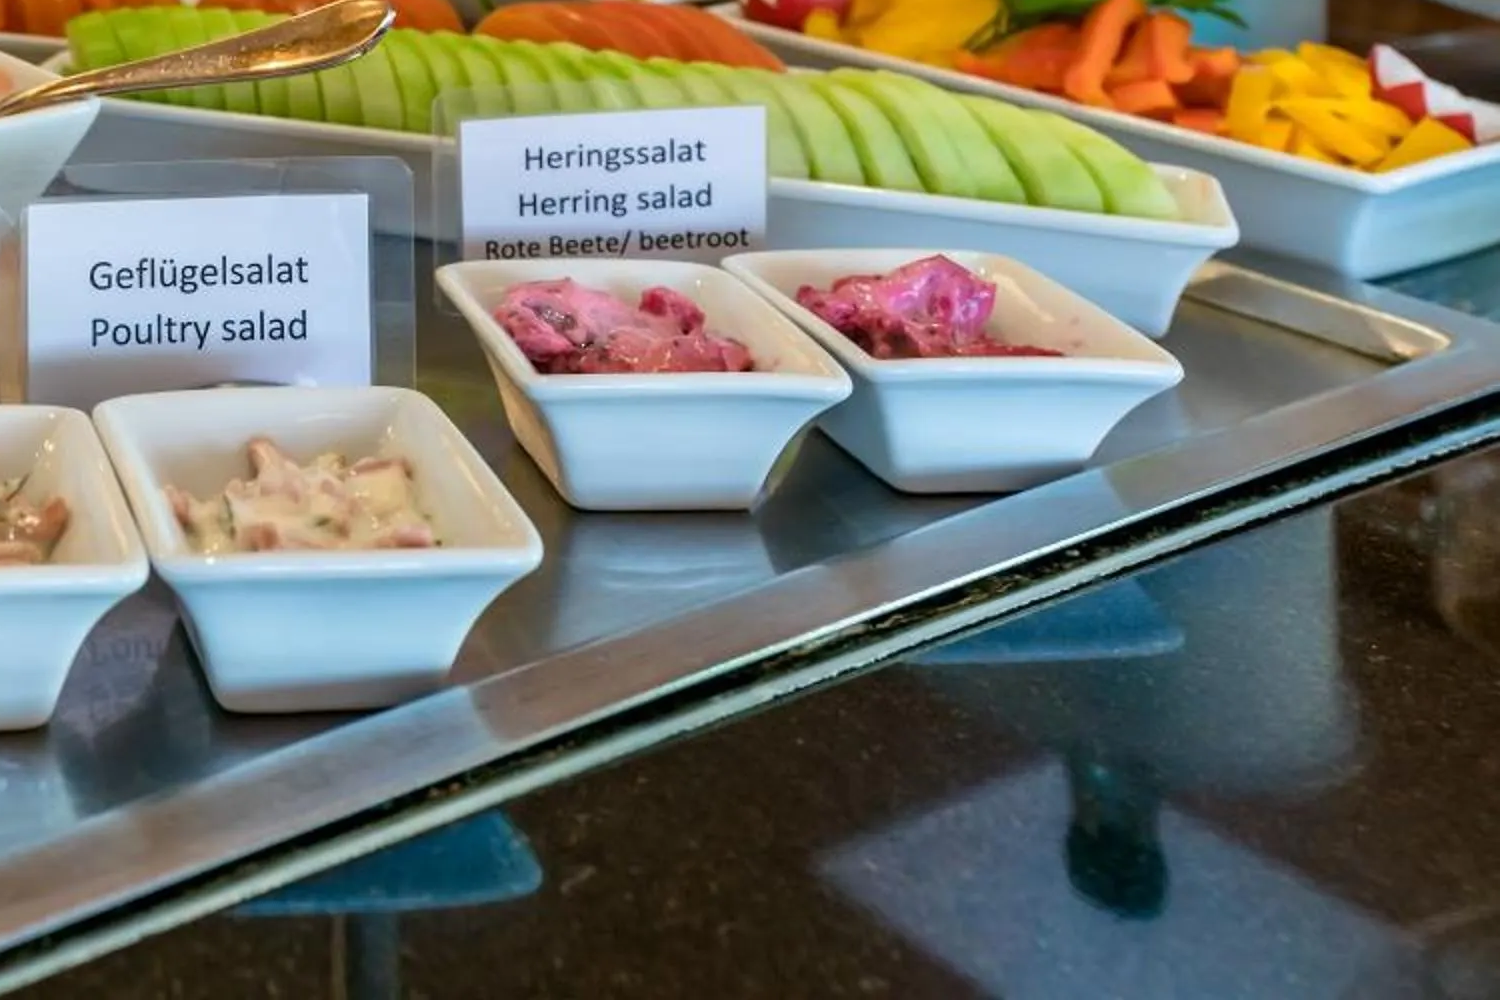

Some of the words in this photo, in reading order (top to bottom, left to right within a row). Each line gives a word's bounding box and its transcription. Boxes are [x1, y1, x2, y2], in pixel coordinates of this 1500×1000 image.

[524, 139, 708, 172] Heringssalat
[518, 189, 628, 218] Herring
[636, 182, 713, 210] salad
[485, 239, 541, 260] Rote
[548, 229, 632, 257] Beete/
[638, 227, 750, 251] beetroot
[88, 253, 309, 294] Geflügelsalat
[90, 313, 211, 350] Poultry
[221, 309, 308, 343] salad
